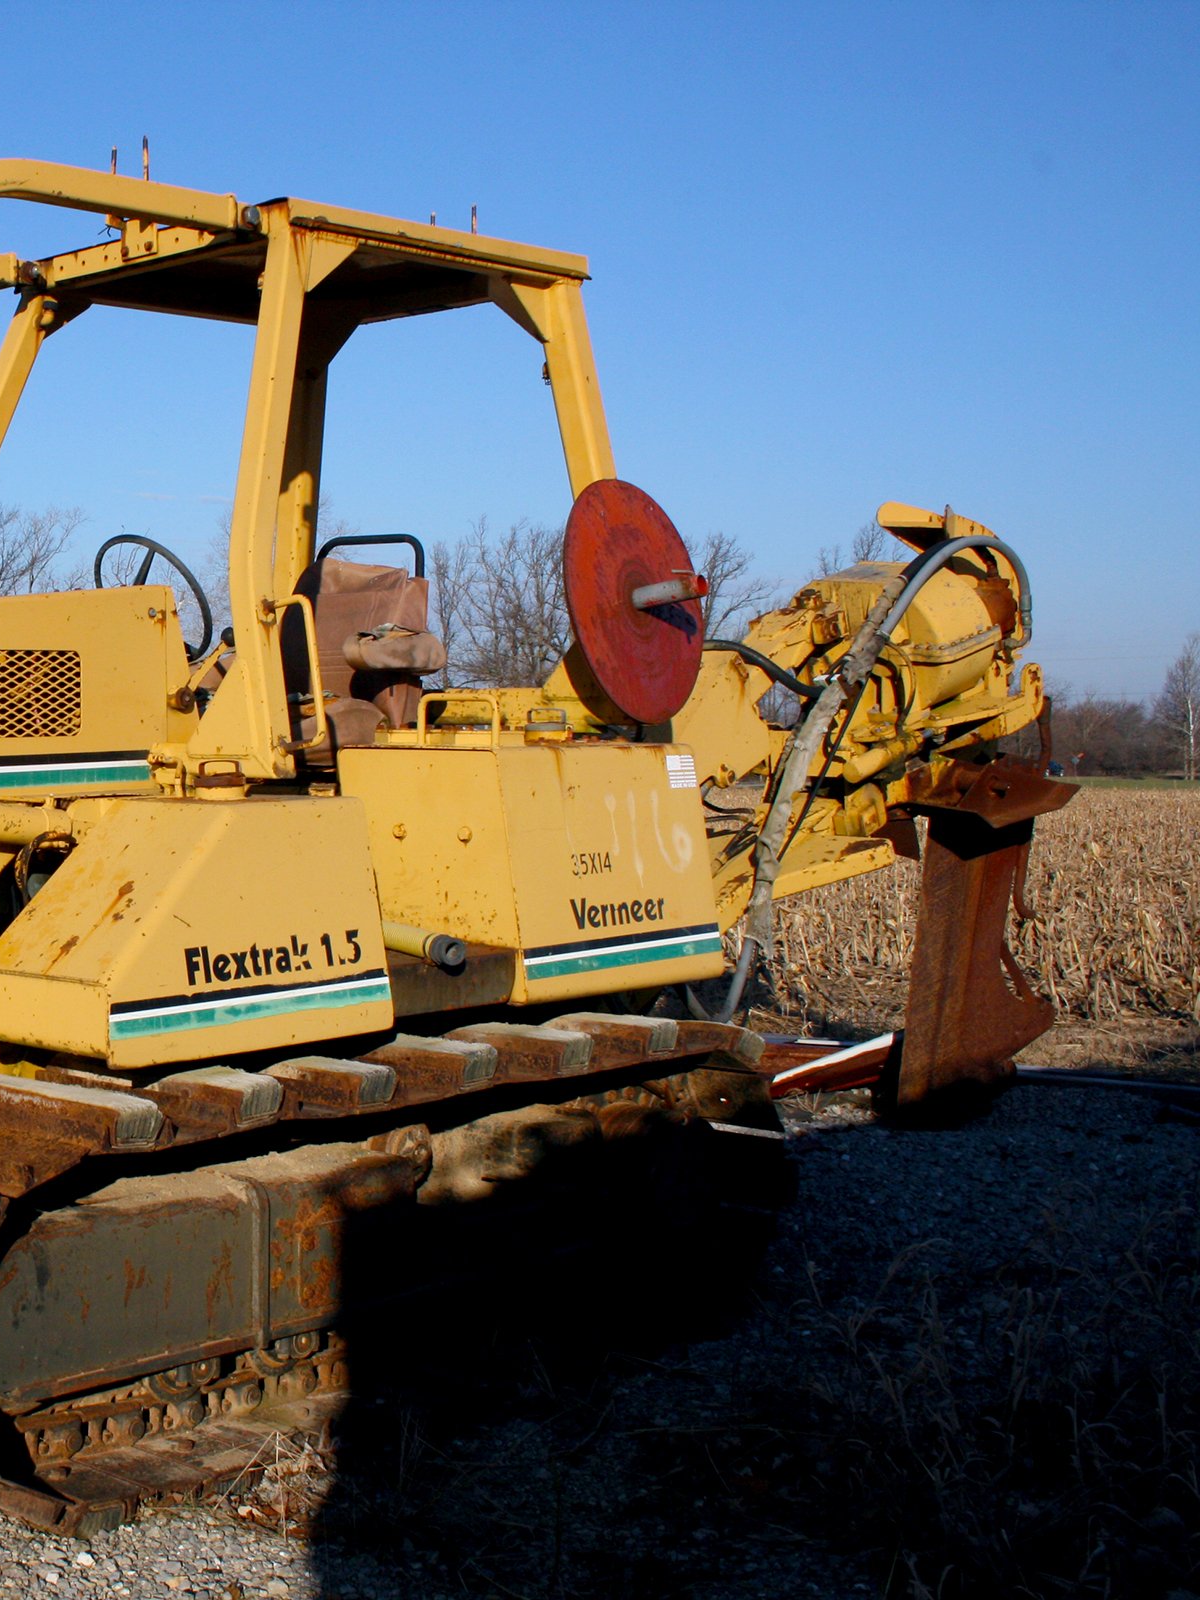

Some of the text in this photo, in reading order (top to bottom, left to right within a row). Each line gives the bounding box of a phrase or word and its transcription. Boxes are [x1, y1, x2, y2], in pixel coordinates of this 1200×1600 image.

[569, 897, 665, 930] Vermeer
[184, 929, 362, 986] Flextrak 1.5
